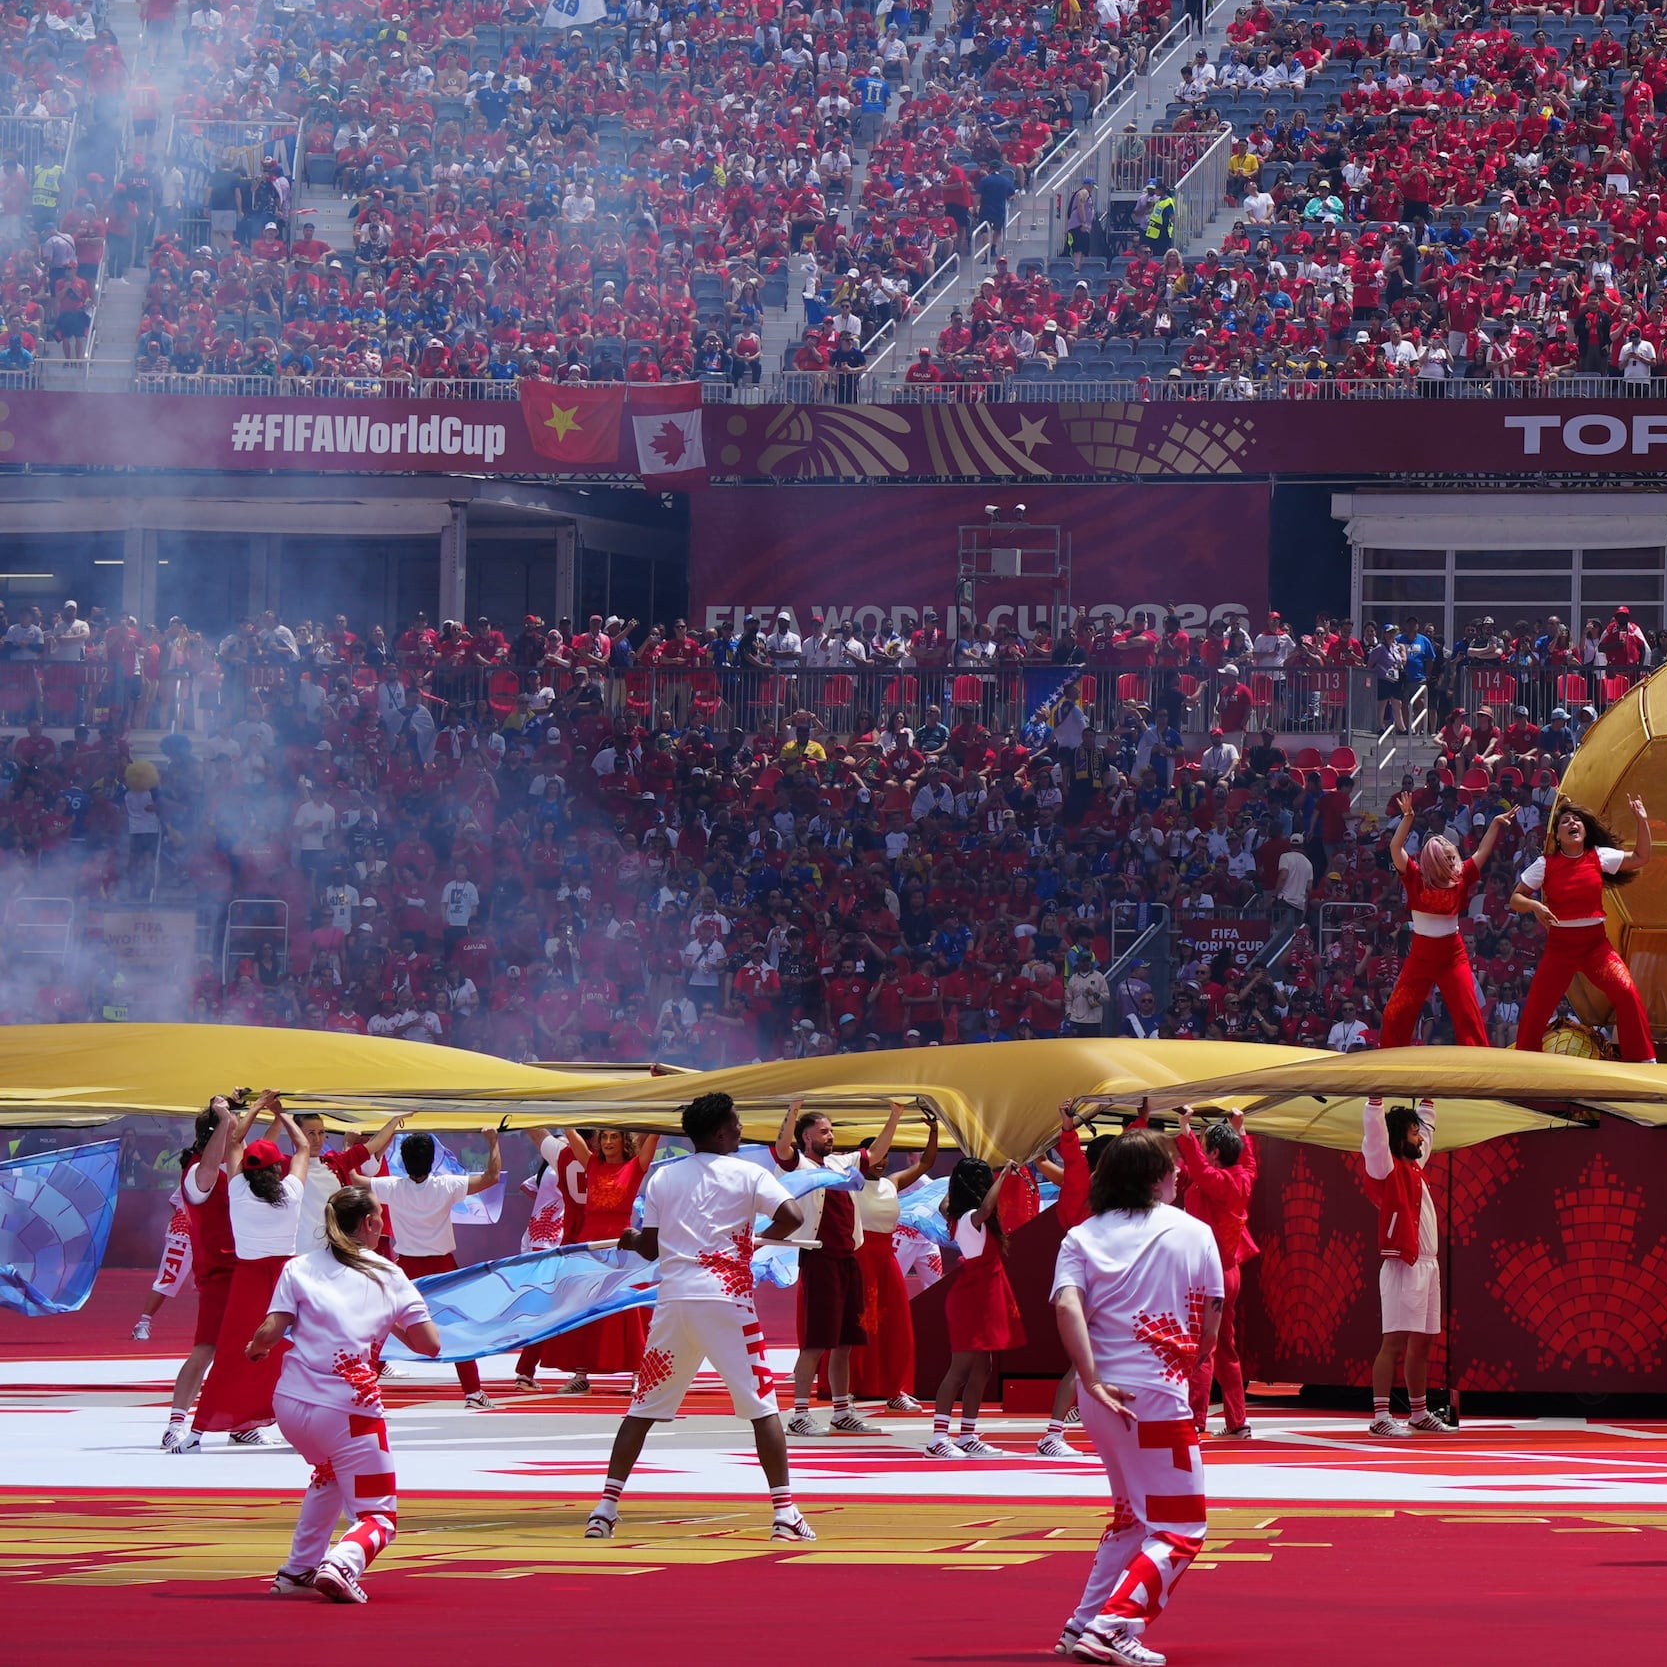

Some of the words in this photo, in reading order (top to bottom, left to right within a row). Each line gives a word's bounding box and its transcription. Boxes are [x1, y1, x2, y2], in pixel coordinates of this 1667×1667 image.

[867, 86, 881, 101] 11
[232, 413, 506, 462] #FIFAWorldCup
[84, 666, 109, 683] 112
[1317, 672, 1340, 688] 113
[1477, 671, 1501, 687] 114
[1211, 928, 1240, 939] FIFA
[1195, 940, 1235, 951] ORLD
[1237, 940, 1265, 952] CUP
[1201, 953, 1248, 965] 26
[159, 1238, 187, 1285] FIFA
